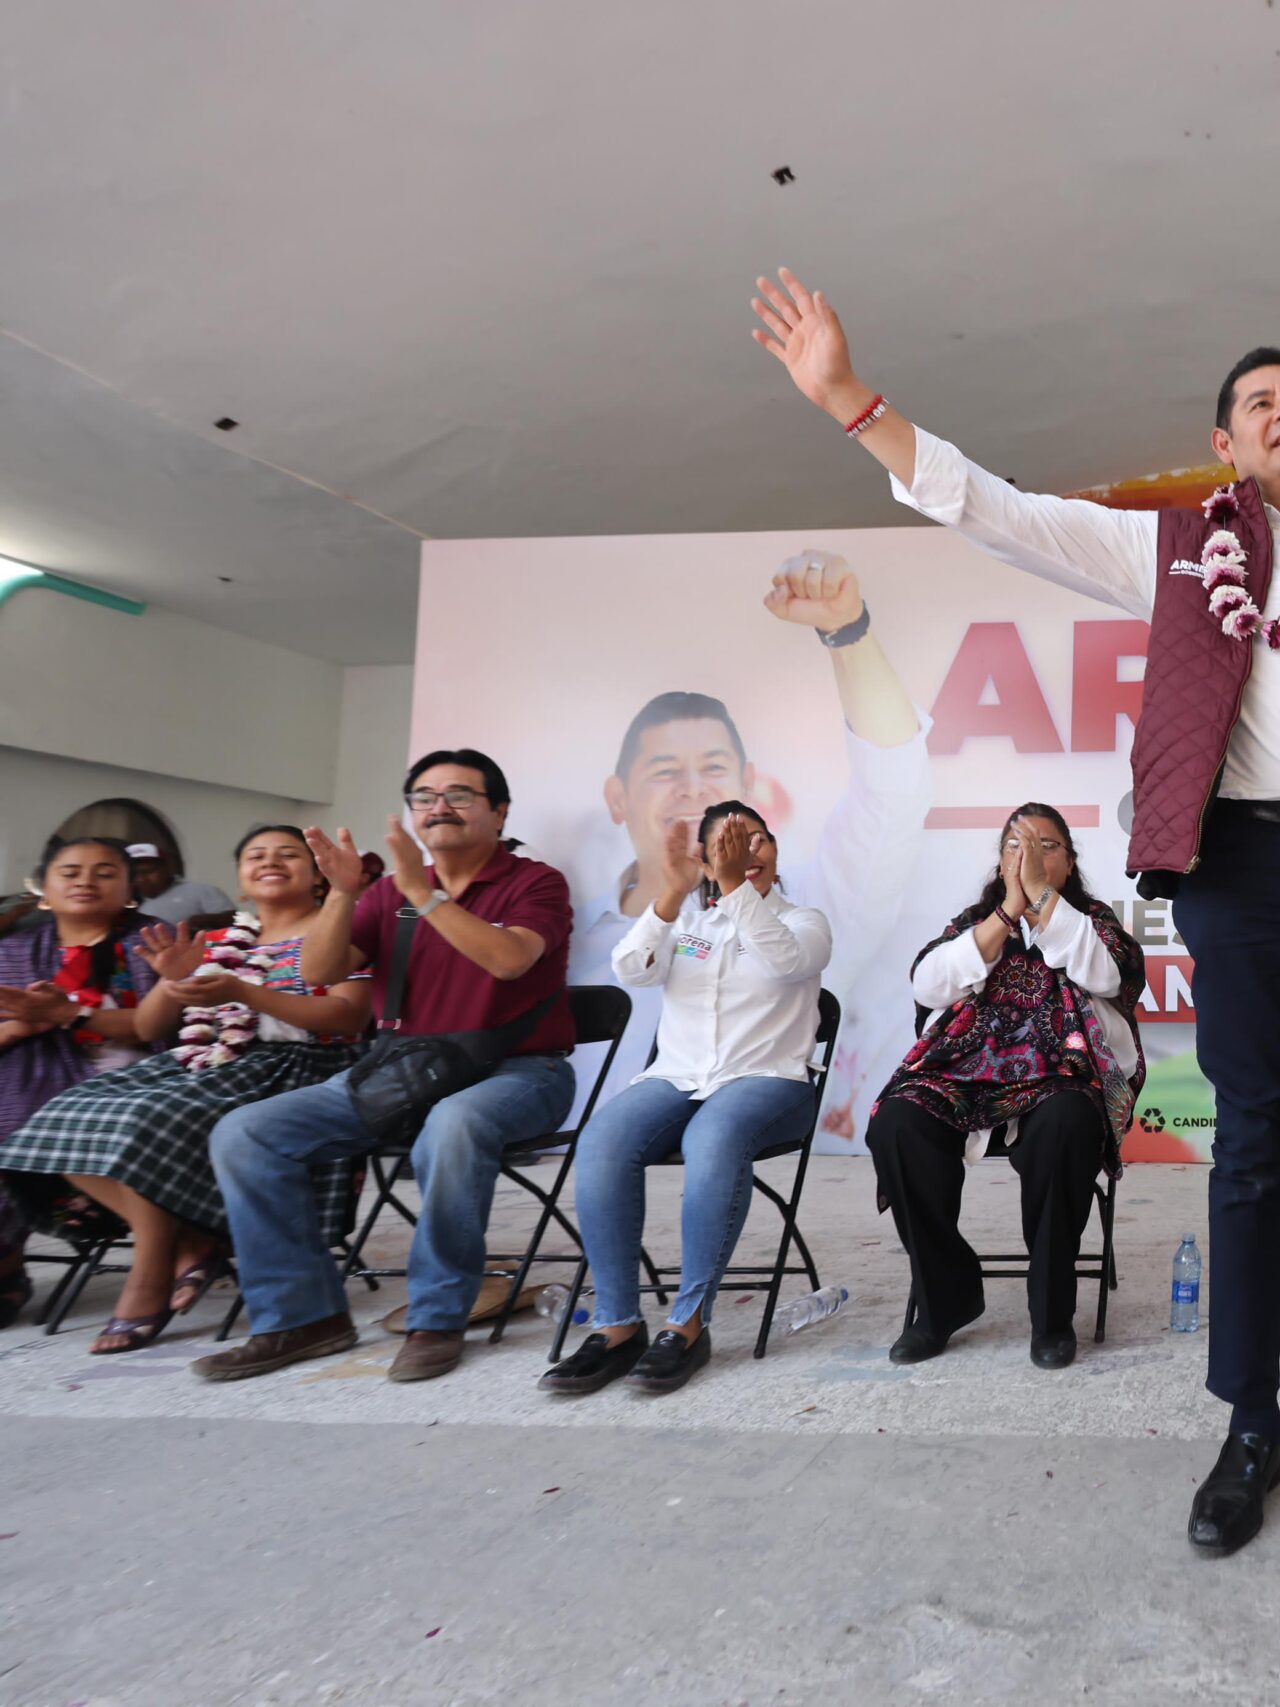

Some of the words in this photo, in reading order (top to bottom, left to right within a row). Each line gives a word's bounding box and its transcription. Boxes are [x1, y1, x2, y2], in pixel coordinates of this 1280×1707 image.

[1170, 560, 1207, 572] ARME
[679, 936, 713, 952] orena
[1172, 1117, 1217, 1128] CANDI
